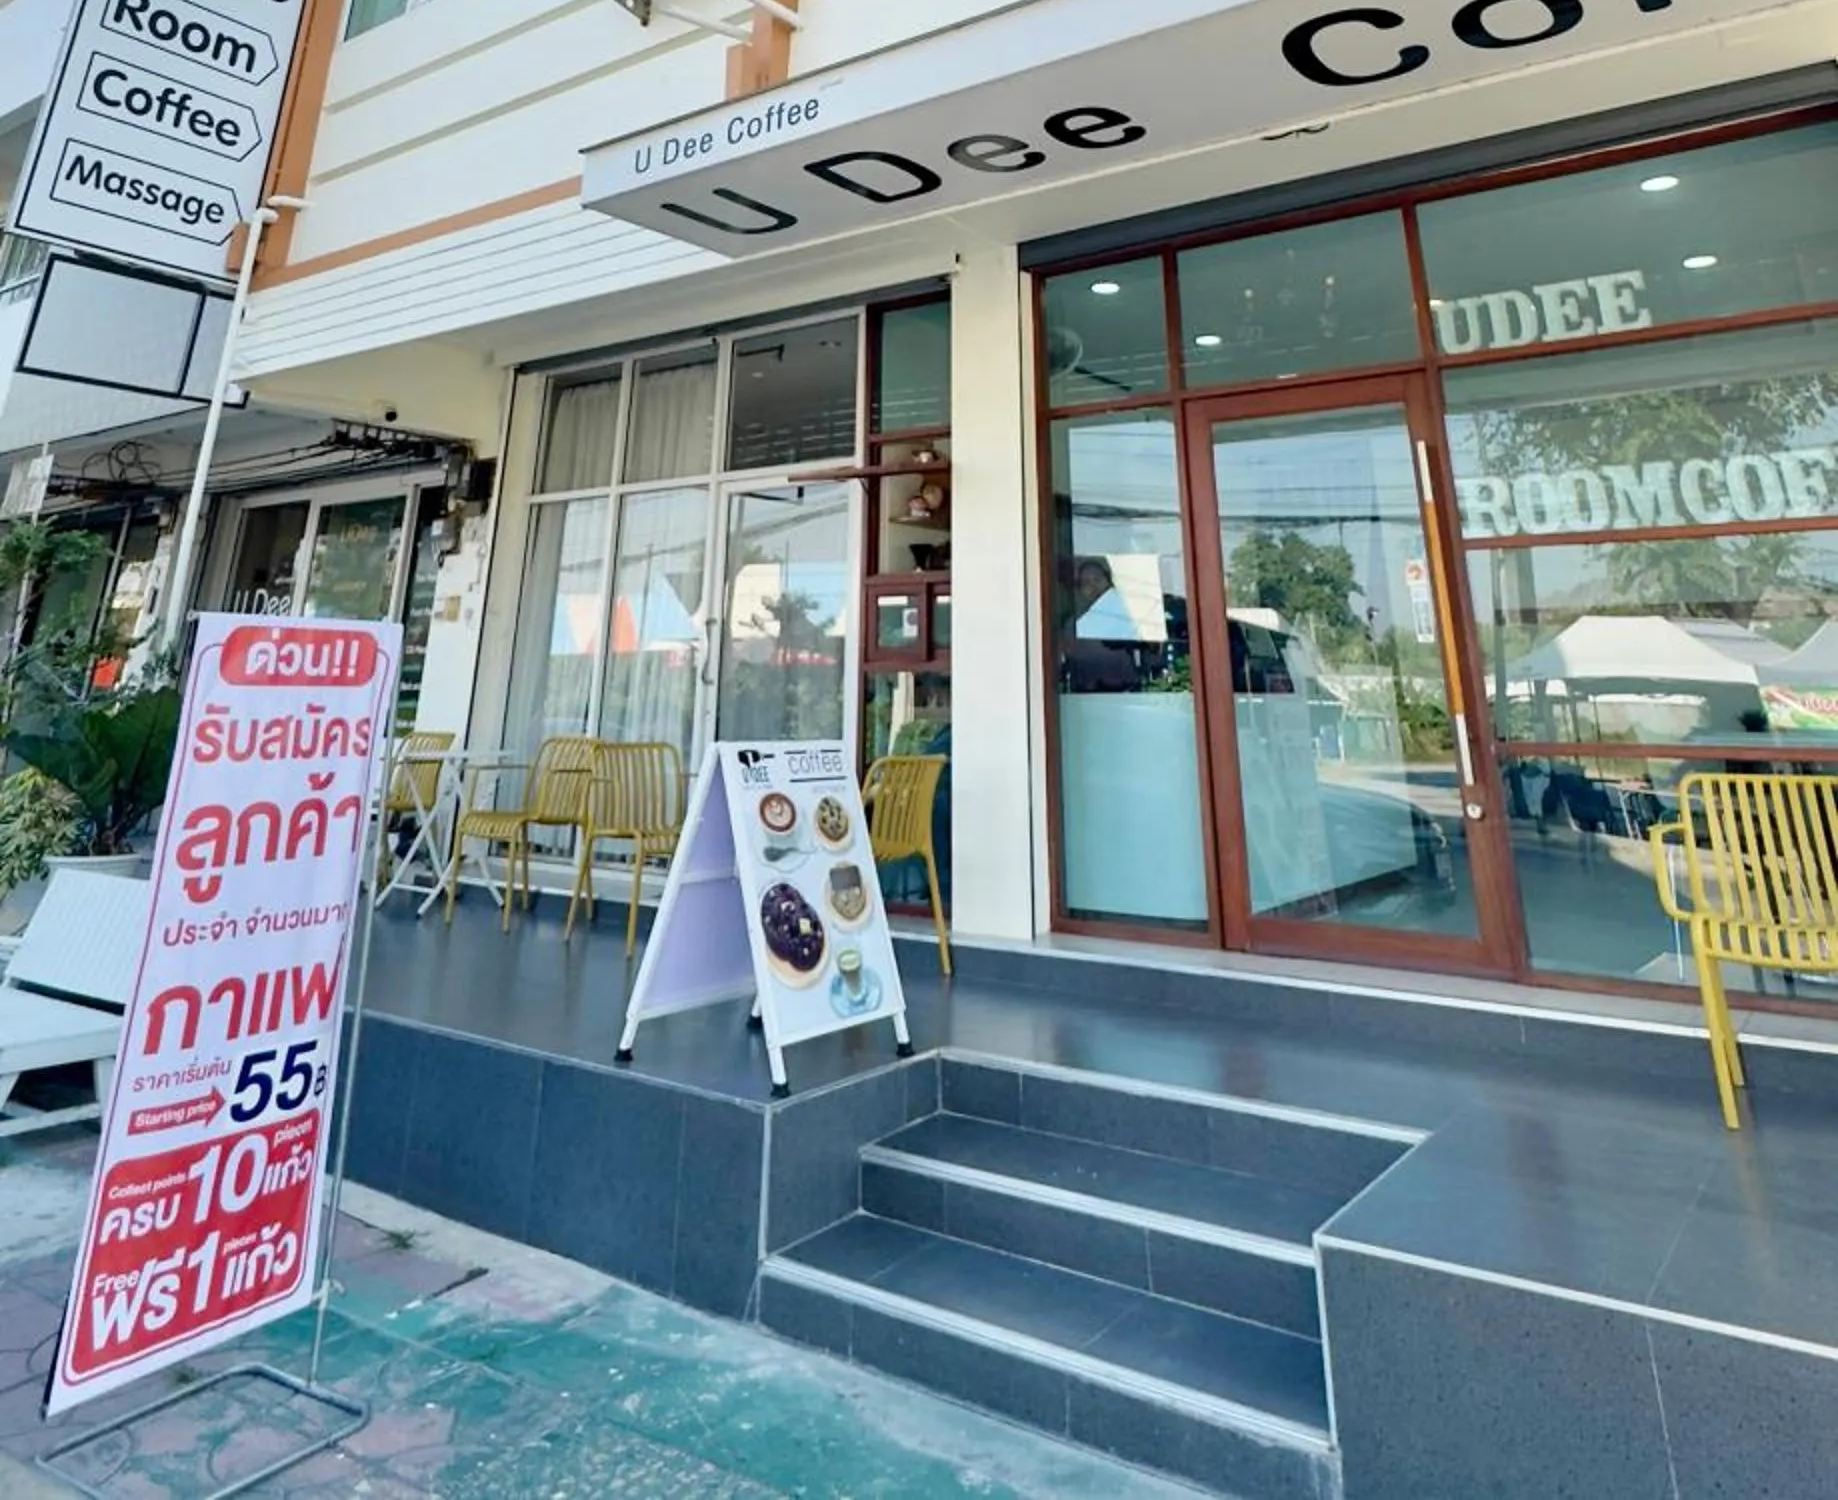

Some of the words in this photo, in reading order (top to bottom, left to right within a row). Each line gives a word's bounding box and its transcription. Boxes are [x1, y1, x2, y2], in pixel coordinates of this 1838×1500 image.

[92, 68, 242, 148] Coffee
[634, 146, 651, 174] U
[663, 131, 714, 166] Dee
[726, 97, 820, 146] Coffee
[64, 154, 225, 225] Massage
[660, 186, 798, 235] U
[803, 106, 1147, 203] Dee
[1430, 269, 1653, 355] UDEE
[244, 627, 360, 678] ด่วน!!
[193, 703, 371, 763] รับสมัคร
[176, 771, 362, 905] ลูกค้า
[163, 910, 238, 947] ประจำ
[131, 1055, 233, 1093] ราคาเริ่มต้น
[134, 1104, 187, 1128] Starting
[99, 1192, 180, 1245] ครบ
[188, 1133, 269, 1224] 10
[261, 1142, 313, 1197] แก้ว
[108, 1179, 151, 1199] Collect
[91, 1245, 187, 1352] ฟรี
[187, 1229, 222, 1314] 1
[221, 1221, 298, 1301] แก้ว
[92, 1269, 140, 1297] Free
